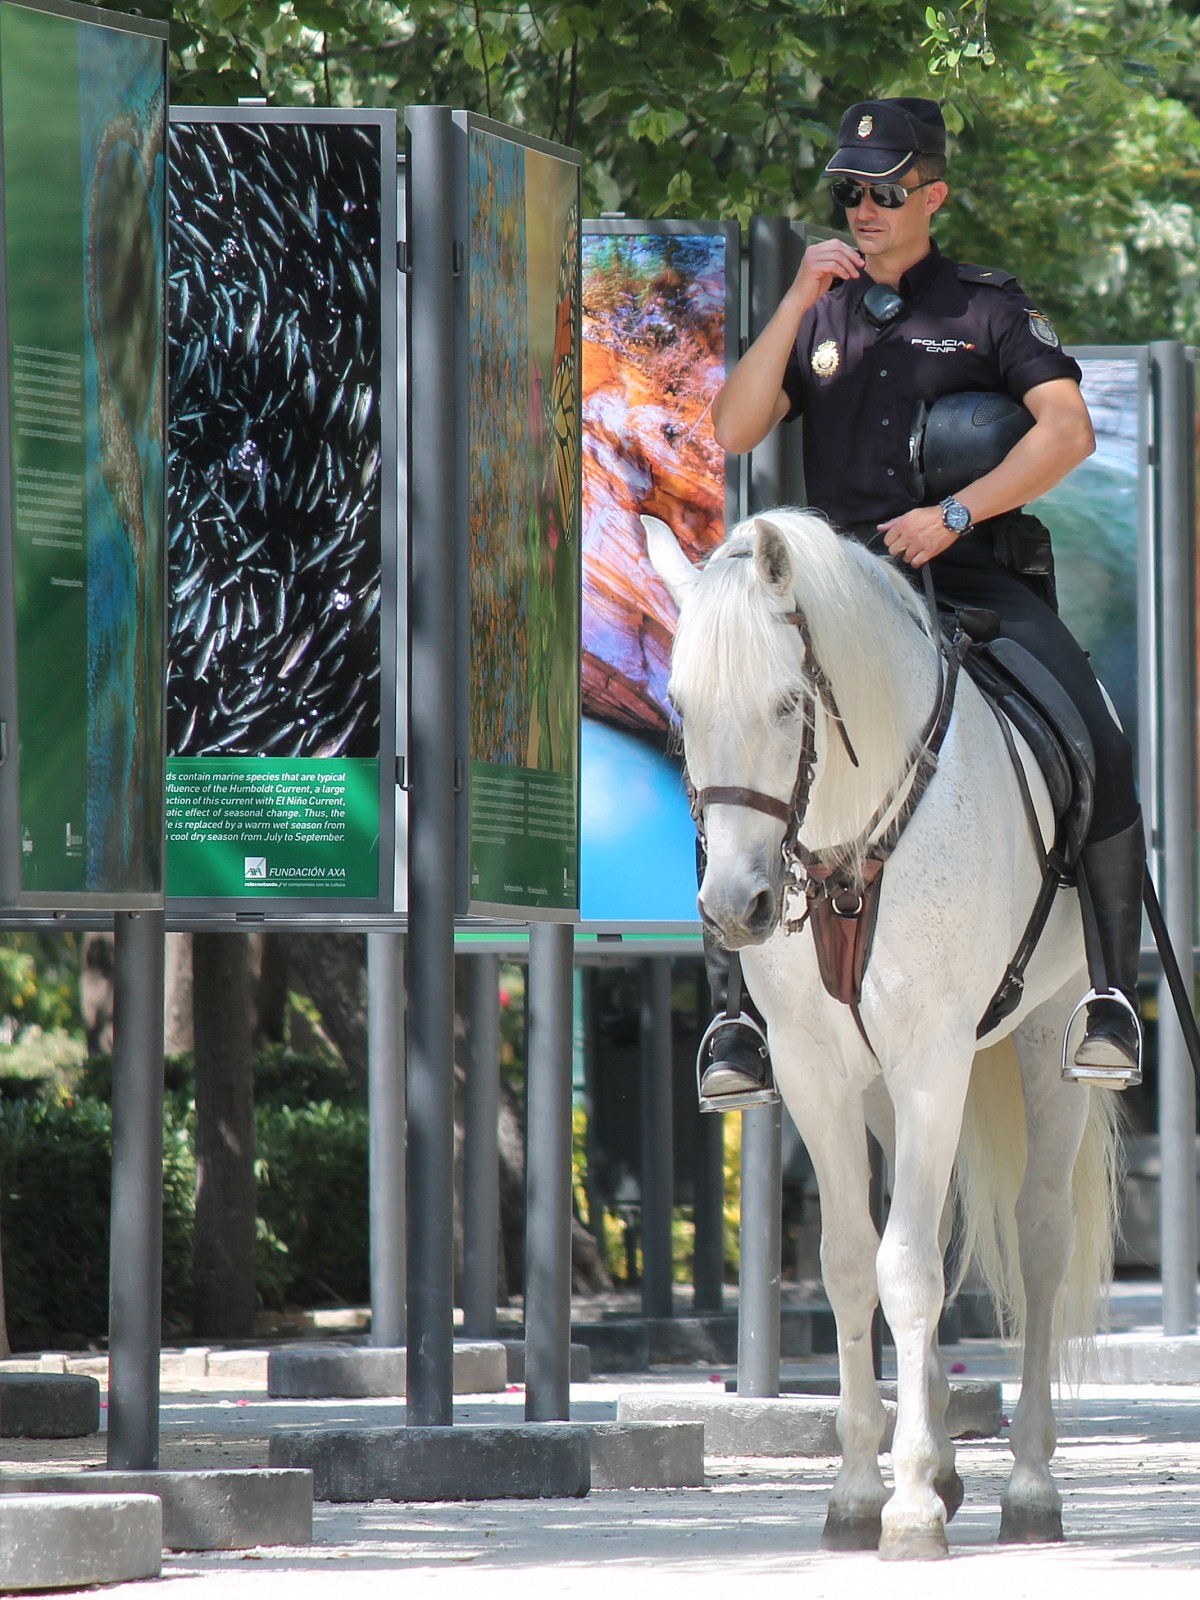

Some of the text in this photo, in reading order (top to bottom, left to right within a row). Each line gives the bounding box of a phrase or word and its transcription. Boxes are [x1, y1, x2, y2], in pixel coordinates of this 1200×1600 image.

[911, 339, 966, 347] POLICIA
[178, 772, 211, 781] contain
[212, 772, 245, 781] marine
[245, 772, 280, 783] species
[281, 772, 299, 781] that
[317, 772, 346, 783] typical
[202, 784, 212, 793] of
[213, 784, 228, 793] the
[229, 784, 274, 793] Humboldt
[275, 784, 313, 794] Current,
[322, 785, 345, 795] large
[192, 796, 202, 805] of
[202, 796, 219, 805] this
[220, 797, 254, 805] current
[255, 796, 274, 805] with
[275, 796, 285, 805] El
[286, 796, 307, 805] Niño
[309, 796, 346, 806] Current,
[185, 808, 210, 817] effect
[212, 808, 222, 817] of
[224, 808, 264, 817] seasonal
[266, 809, 301, 819] change.
[304, 808, 328, 818] Thus,
[330, 809, 345, 817] the
[174, 820, 183, 829] is
[184, 820, 223, 830] replaced
[225, 820, 236, 830] by
[273, 821, 289, 829] wet
[323, 820, 345, 829] from
[170, 832, 189, 841] cool
[190, 832, 206, 843] dry
[207, 833, 239, 841] season
[240, 832, 262, 841] from
[263, 832, 283, 843] July
[284, 833, 293, 841] to
[295, 832, 345, 843] September.
[269, 866, 346, 877] FUNDACIÓN AXA
